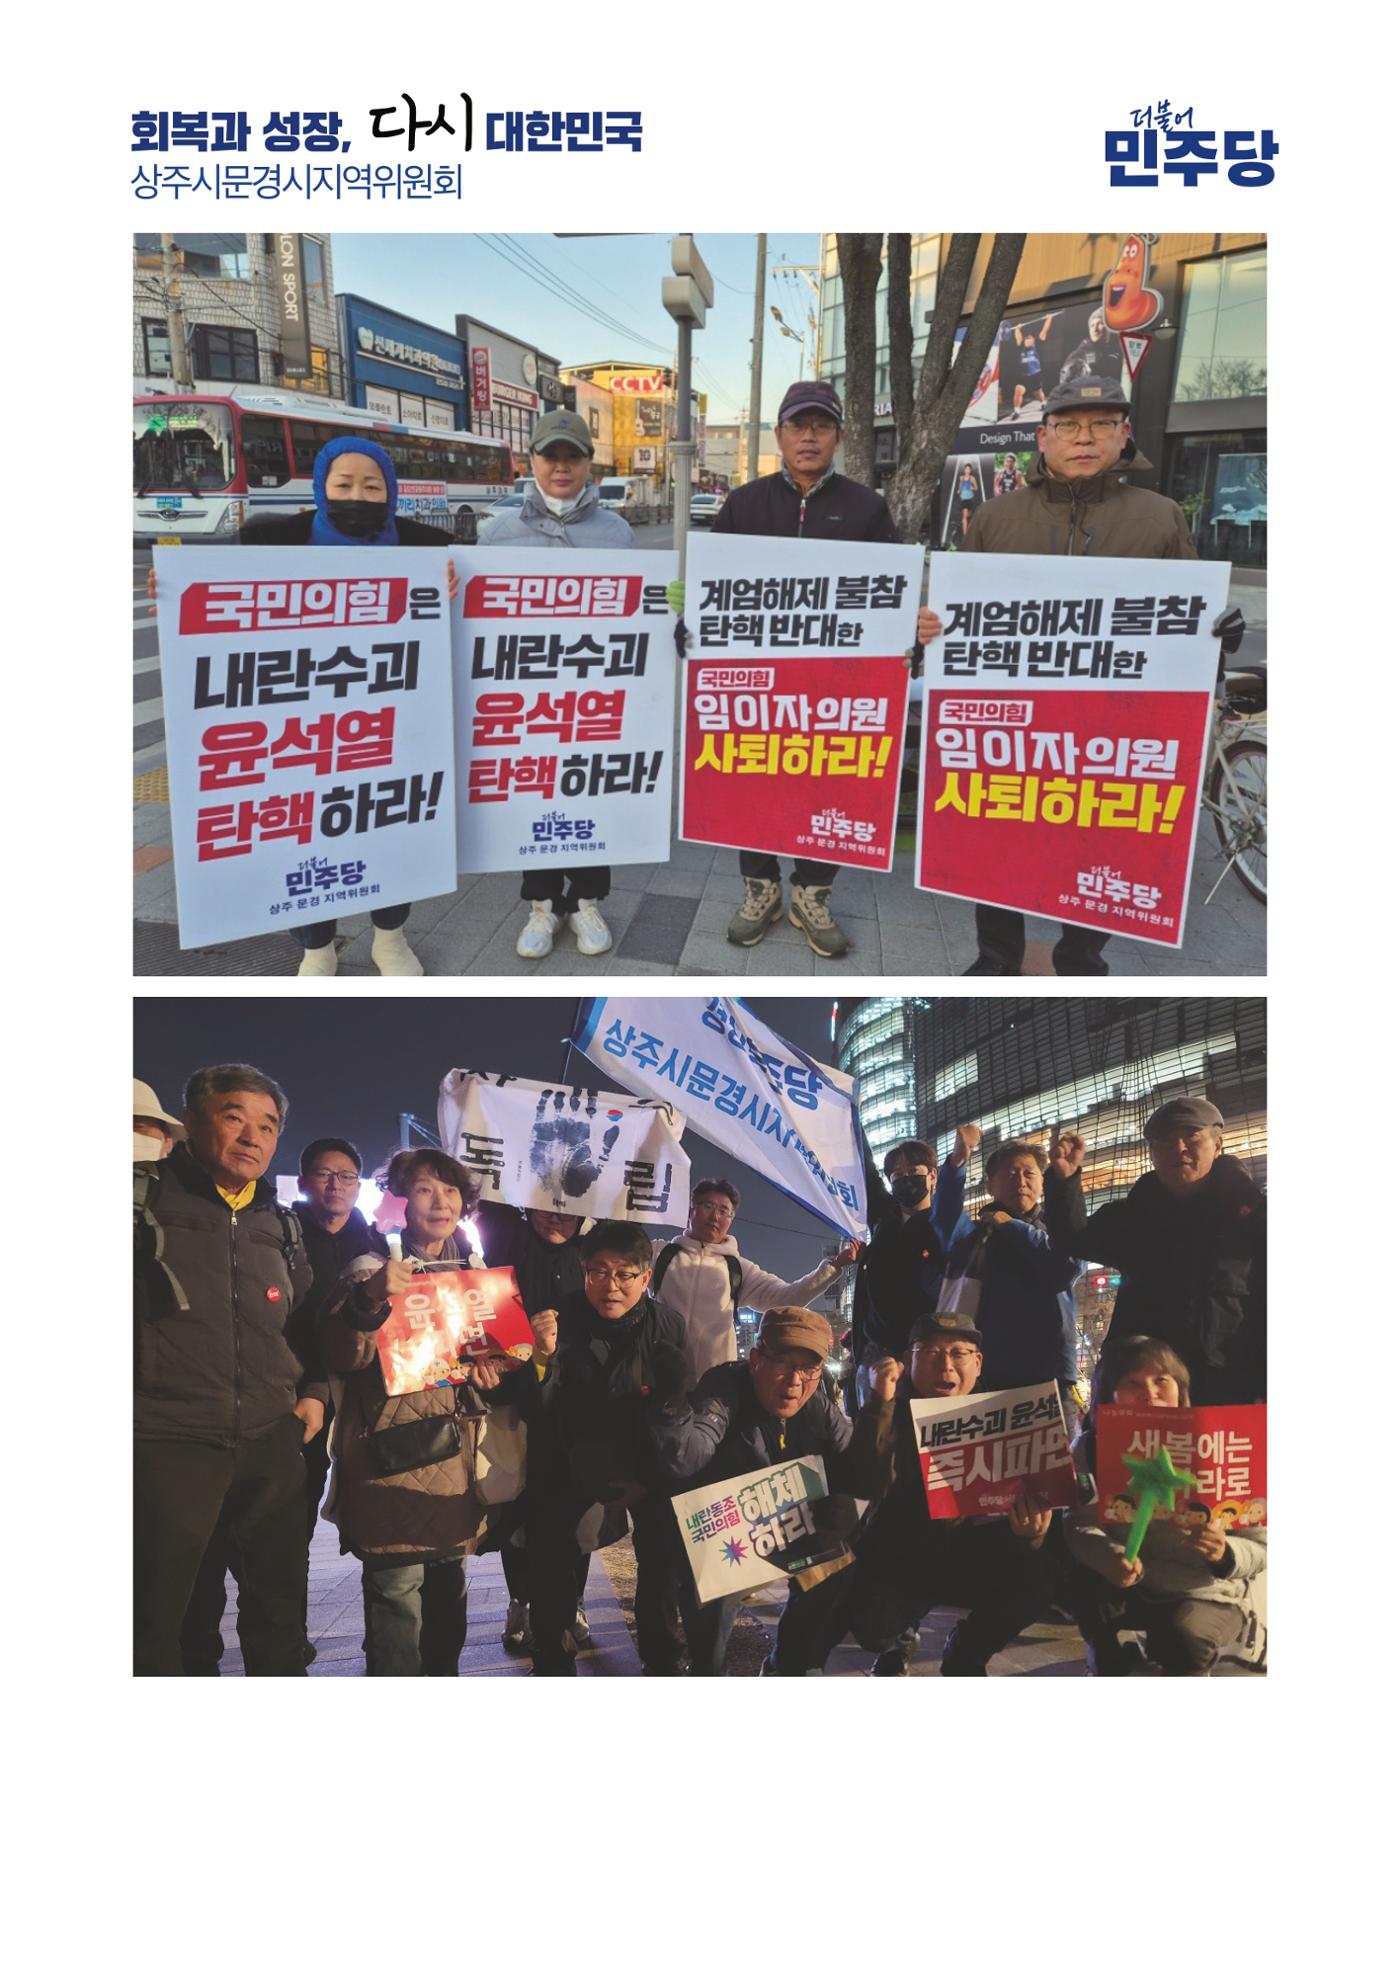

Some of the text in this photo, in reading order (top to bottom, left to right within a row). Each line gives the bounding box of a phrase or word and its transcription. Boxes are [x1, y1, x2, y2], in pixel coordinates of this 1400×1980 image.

[283, 273, 299, 321] SPORT
[610, 376, 661, 391] CCTV
[638, 448, 651, 461] 10
[980, 431, 1036, 446] Design That
[699, 574, 908, 611] 계엄해제 불참
[699, 613, 864, 647] 탄핵 반대한
[944, 595, 1207, 637] 계엄해제 불참
[194, 640, 420, 710] 내란수괴
[471, 633, 650, 681] 내란수괴
[943, 640, 1147, 679] 탄핵 반대한
[701, 670, 770, 688] 국민의힘
[472, 689, 626, 747] 윤석열
[694, 694, 888, 732] 임이자 의원
[943, 702, 1027, 724] 국민의힘
[198, 706, 396, 792] 윤석열
[694, 732, 893, 778] 사퇴하라!
[935, 728, 1180, 780] 임이자 의원
[934, 771, 1187, 834] 사퇴하라!
[532, 819, 596, 842] 민주당
[810, 814, 876, 842] 민주당
[285, 860, 367, 897] 민주당
[297, 855, 328, 871] 더불어
[269, 902, 294, 915] 상주
[1076, 871, 1162, 910] 민주당
[920, 1393, 1063, 1448] 내란수괴 윤석
[927, 1425, 1073, 1492] 즉시파면
[738, 1461, 808, 1522] 해체
[685, 1495, 738, 1531] 내란동조
[690, 1510, 741, 1544] 국민의힘
[750, 1500, 816, 1558] 하라
